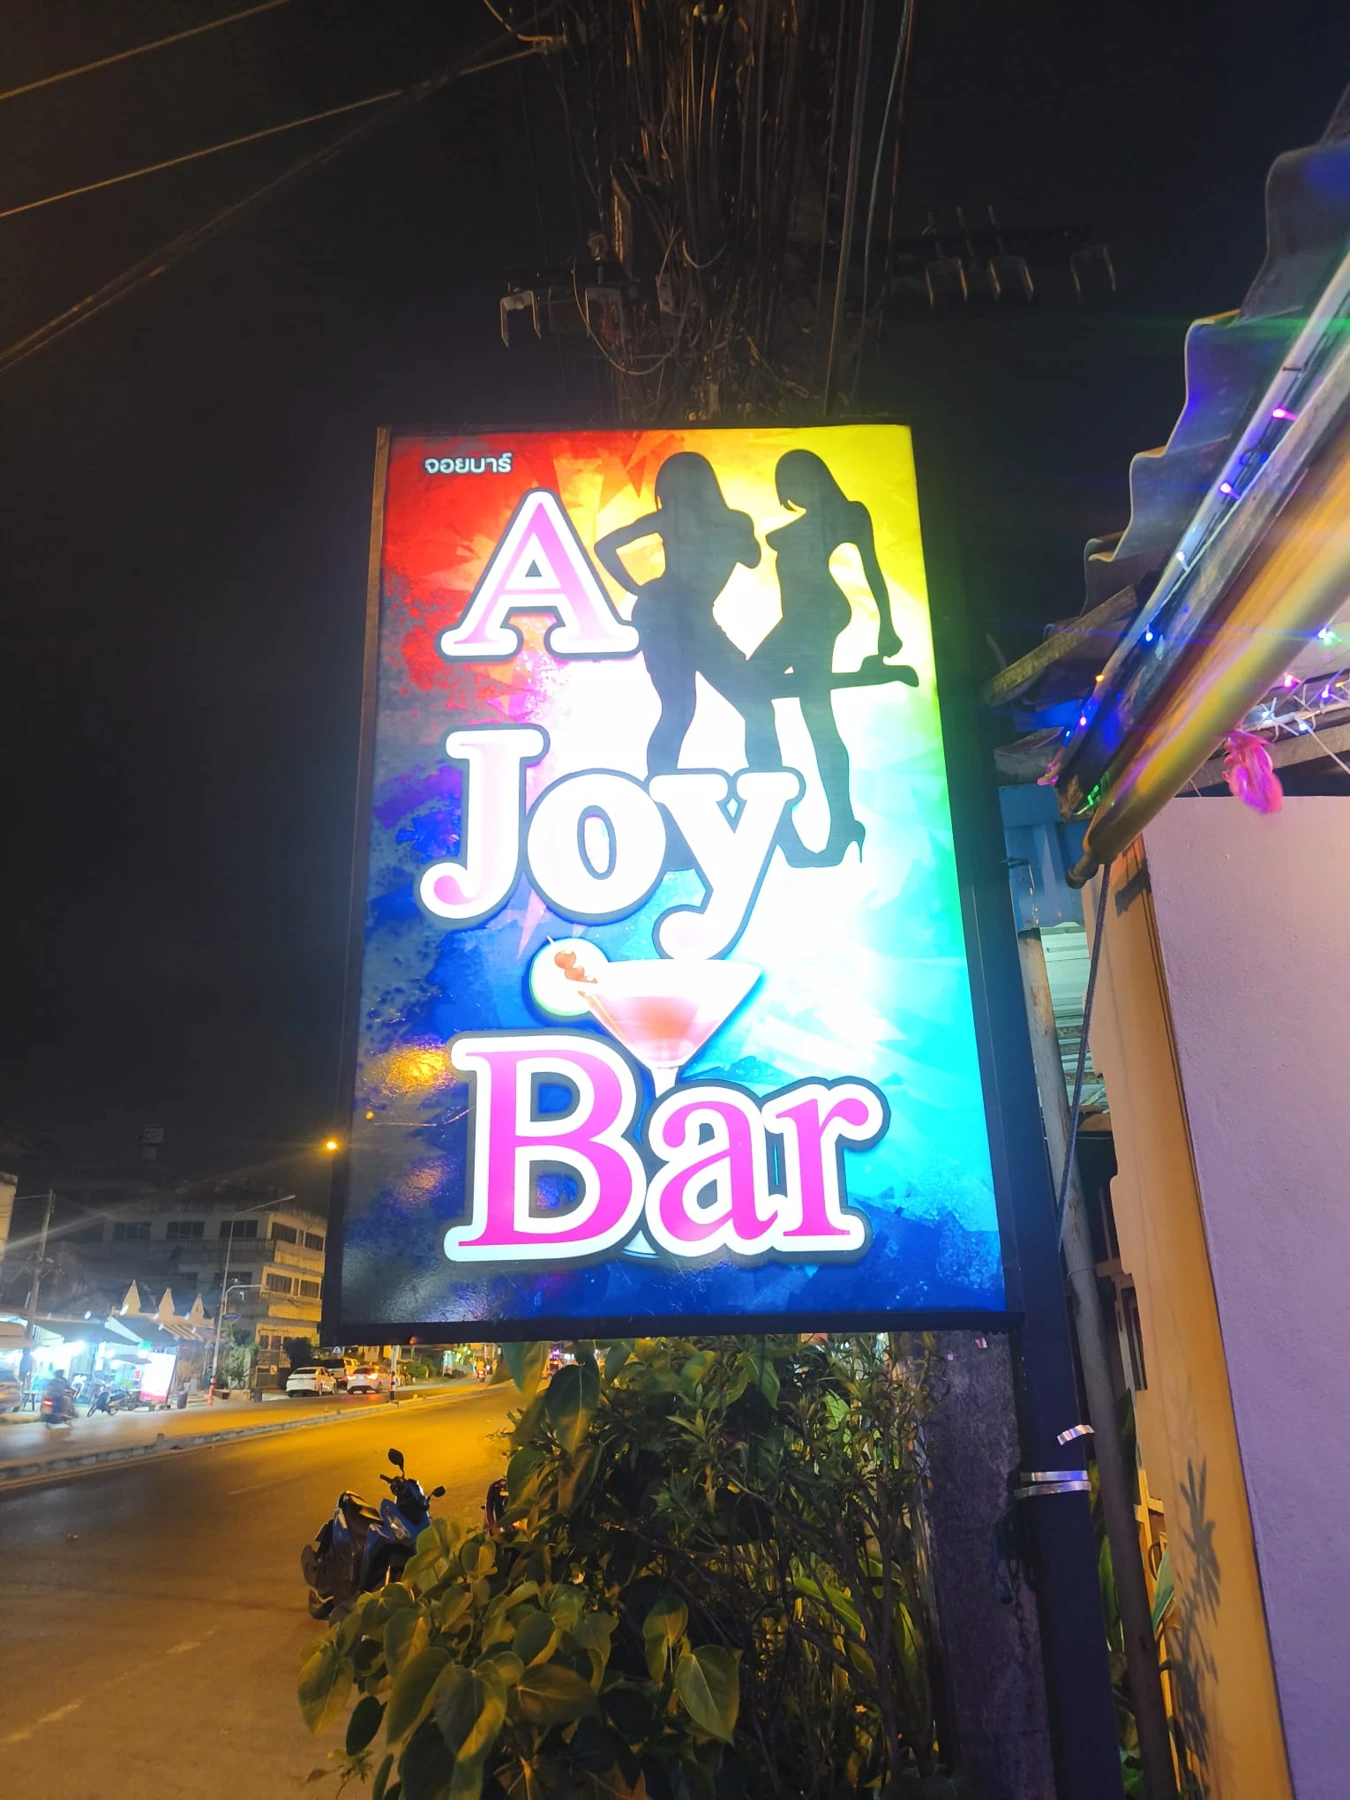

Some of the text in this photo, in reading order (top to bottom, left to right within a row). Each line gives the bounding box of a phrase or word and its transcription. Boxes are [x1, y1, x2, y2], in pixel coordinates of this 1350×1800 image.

[424, 452, 513, 474] จอยบาร์
[440, 488, 641, 657] A
[420, 728, 804, 960] Joy
[444, 1034, 887, 1263] Bar
